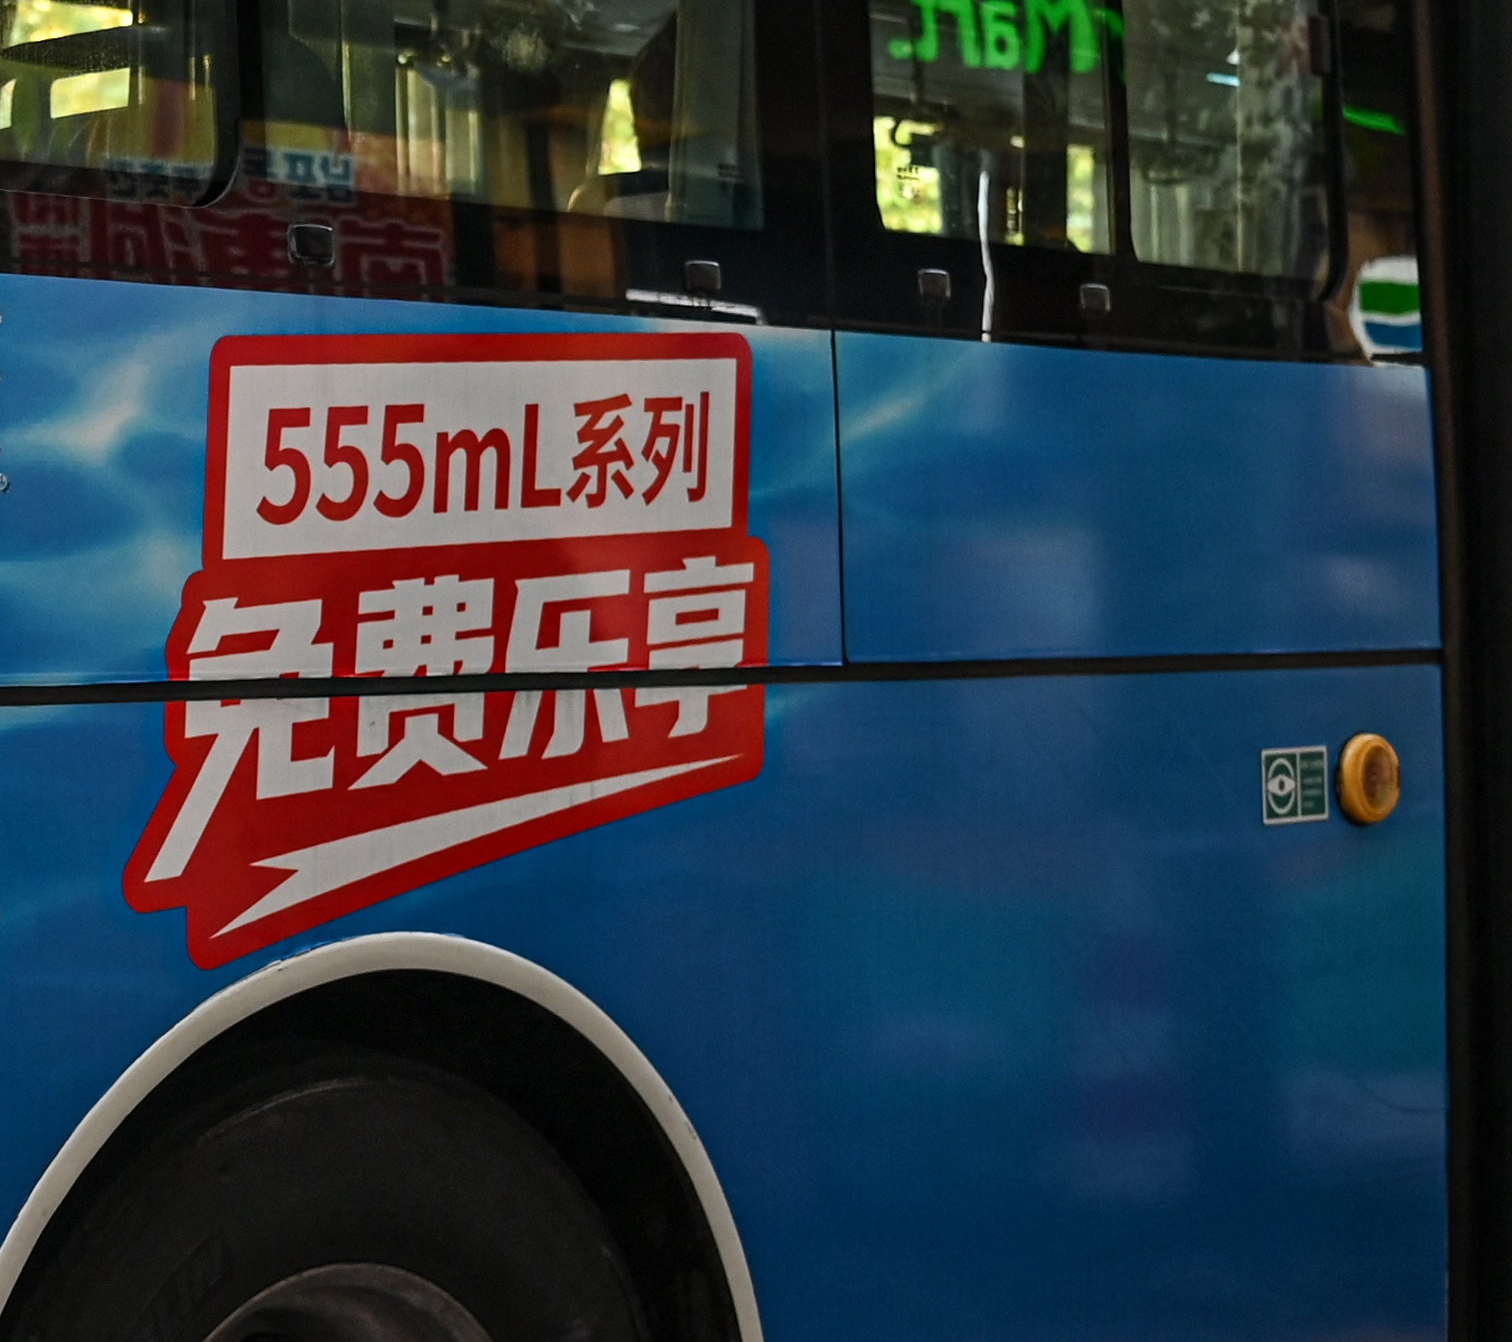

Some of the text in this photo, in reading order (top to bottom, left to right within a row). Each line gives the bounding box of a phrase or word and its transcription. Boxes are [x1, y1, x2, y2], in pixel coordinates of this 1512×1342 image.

[256, 391, 710, 525] 555mL系列
[144, 555, 754, 883] 免费乐享
